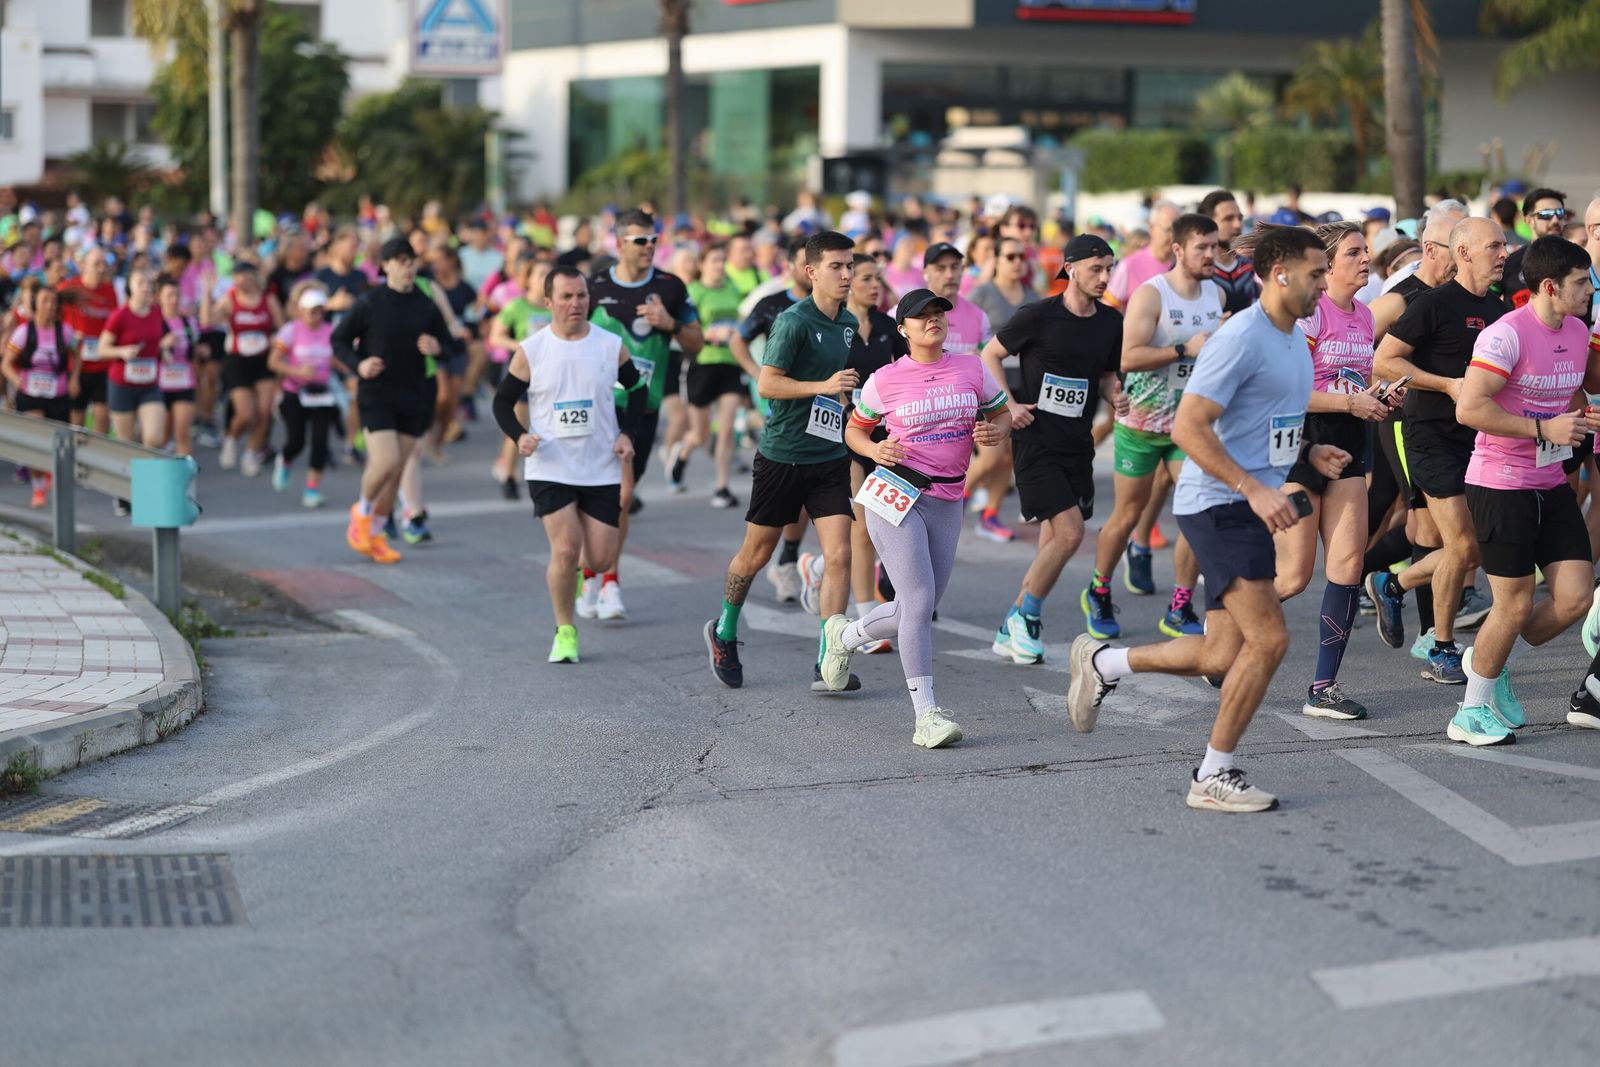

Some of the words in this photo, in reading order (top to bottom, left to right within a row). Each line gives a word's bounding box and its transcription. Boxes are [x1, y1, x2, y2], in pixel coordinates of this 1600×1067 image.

[1318, 340, 1350, 354] MEDIA
[1553, 360, 1574, 373] XXXVI
[1517, 374, 1557, 390] MEDIA
[926, 384, 955, 398] XXXVI
[1045, 386, 1085, 405] 1983
[560, 409, 588, 424] 429
[895, 399, 930, 418] MEDIA
[814, 407, 841, 430] 1079
[902, 411, 962, 427] INTERNACIONAL
[865, 477, 910, 512] 1133
